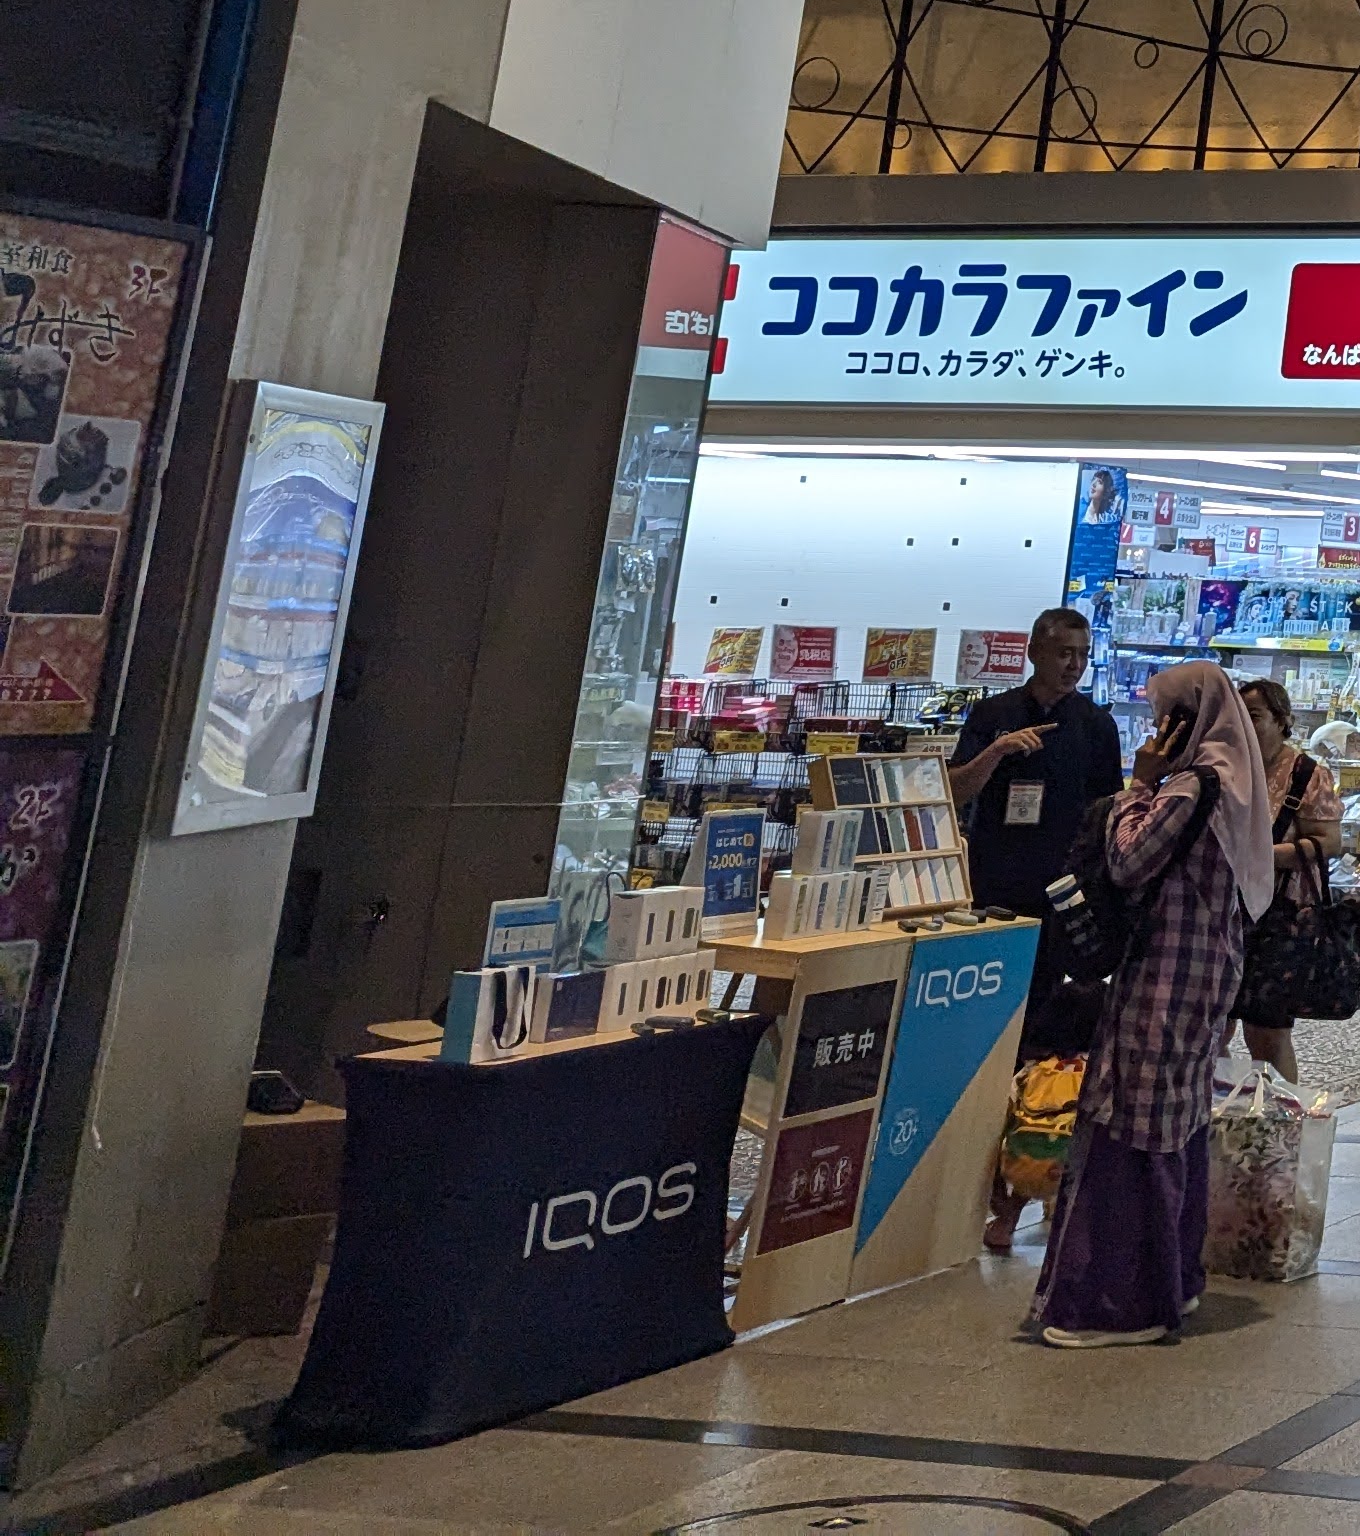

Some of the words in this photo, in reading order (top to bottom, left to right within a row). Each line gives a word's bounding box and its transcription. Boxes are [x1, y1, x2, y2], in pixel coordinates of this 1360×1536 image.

[761, 264, 1248, 337] ココカラファイン
[844, 349, 1126, 379] ココロ、カラダ、ゲンキ。
[1160, 497, 1170, 519] 4
[914, 960, 1003, 1009] IQOS
[812, 1027, 876, 1068] 販売中
[522, 1162, 697, 1259] IQOS
